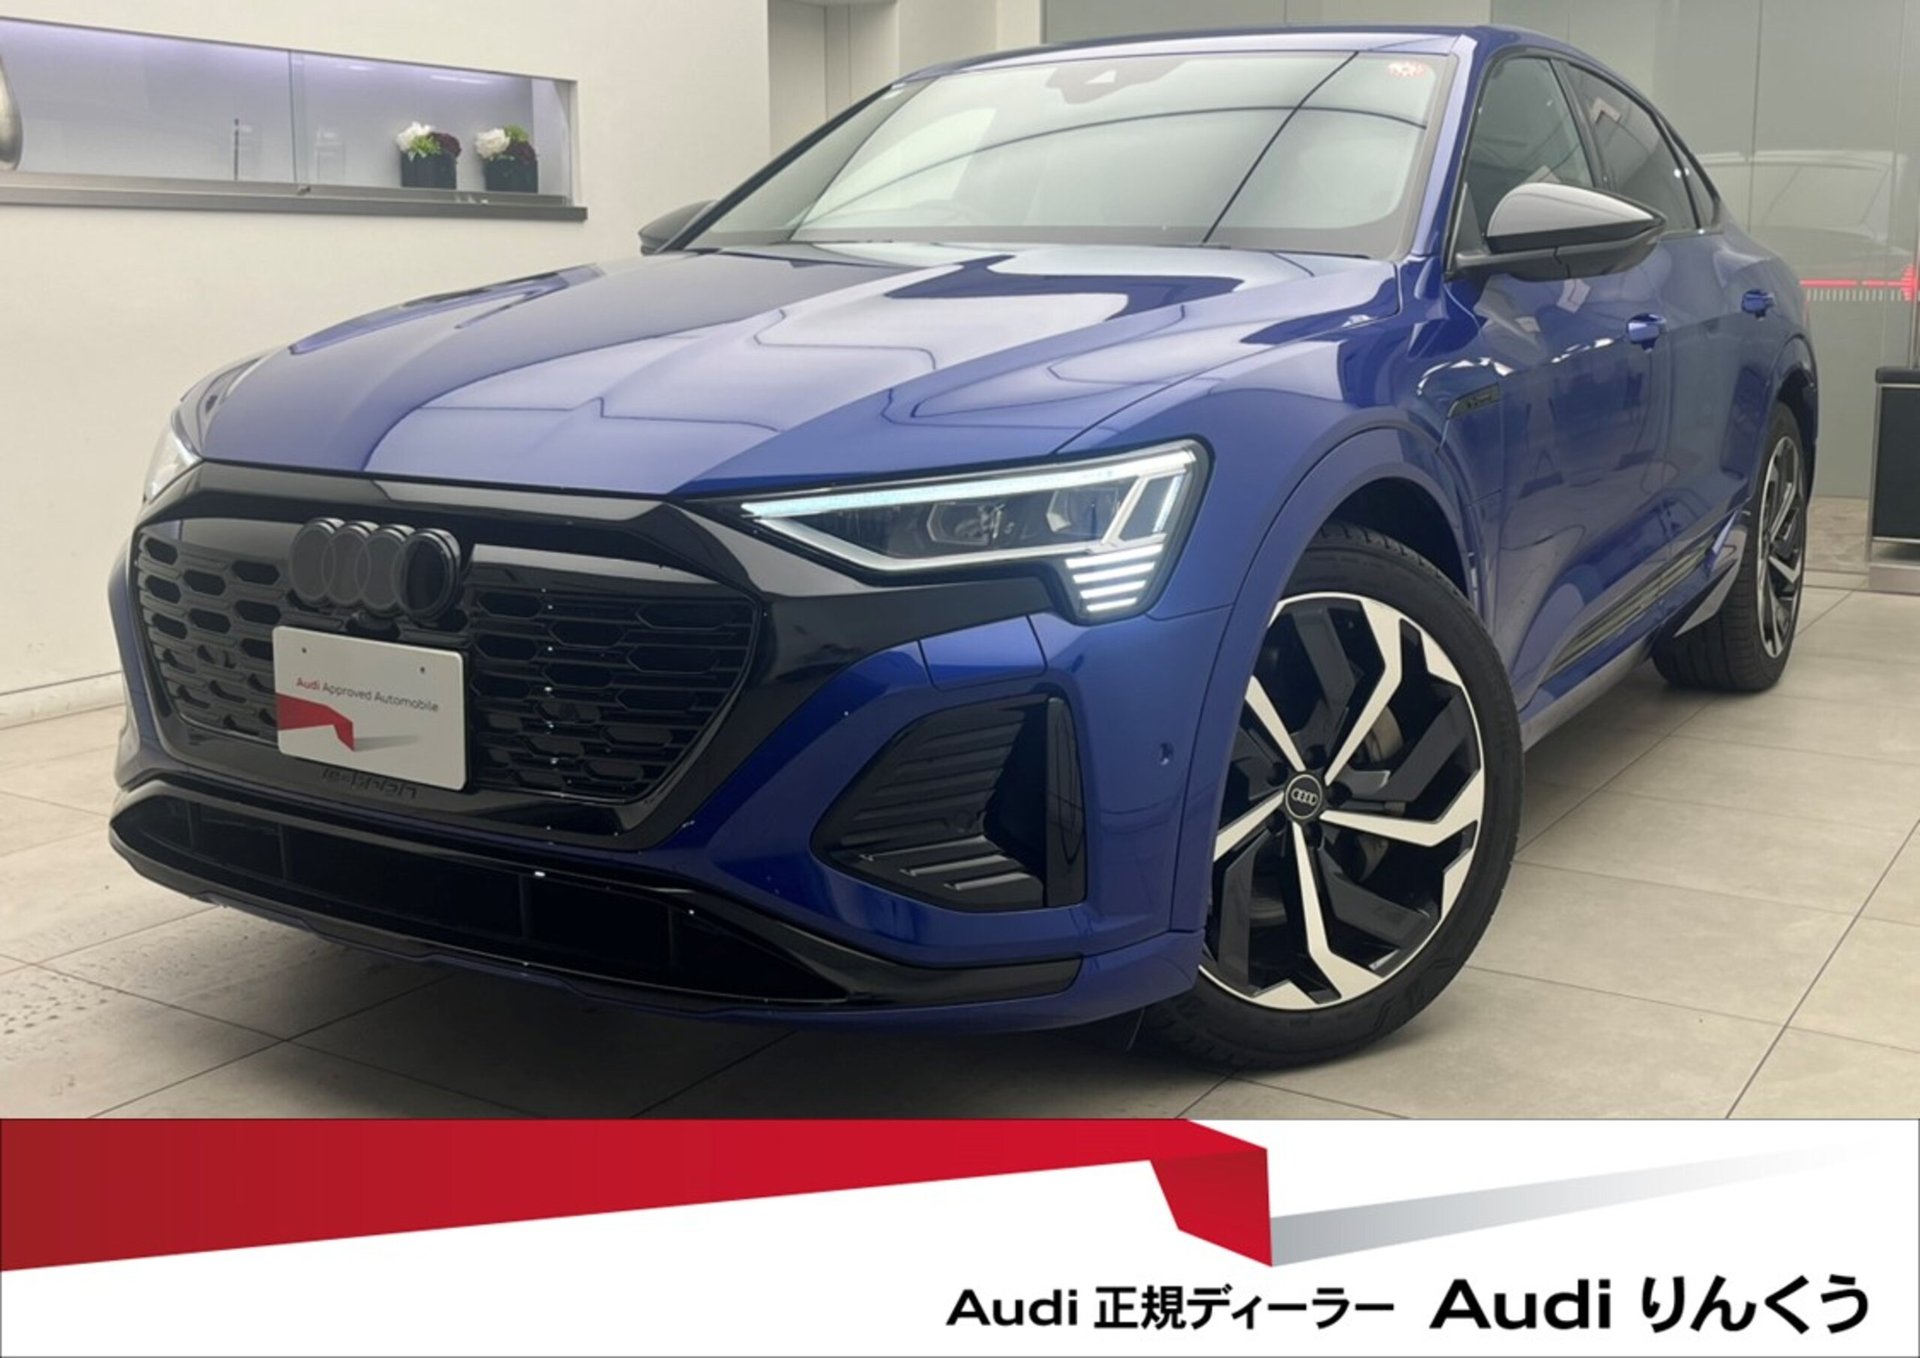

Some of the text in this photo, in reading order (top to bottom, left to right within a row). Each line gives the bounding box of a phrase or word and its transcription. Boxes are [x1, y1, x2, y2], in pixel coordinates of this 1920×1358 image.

[296, 677, 438, 712] Audi Approved Automobile
